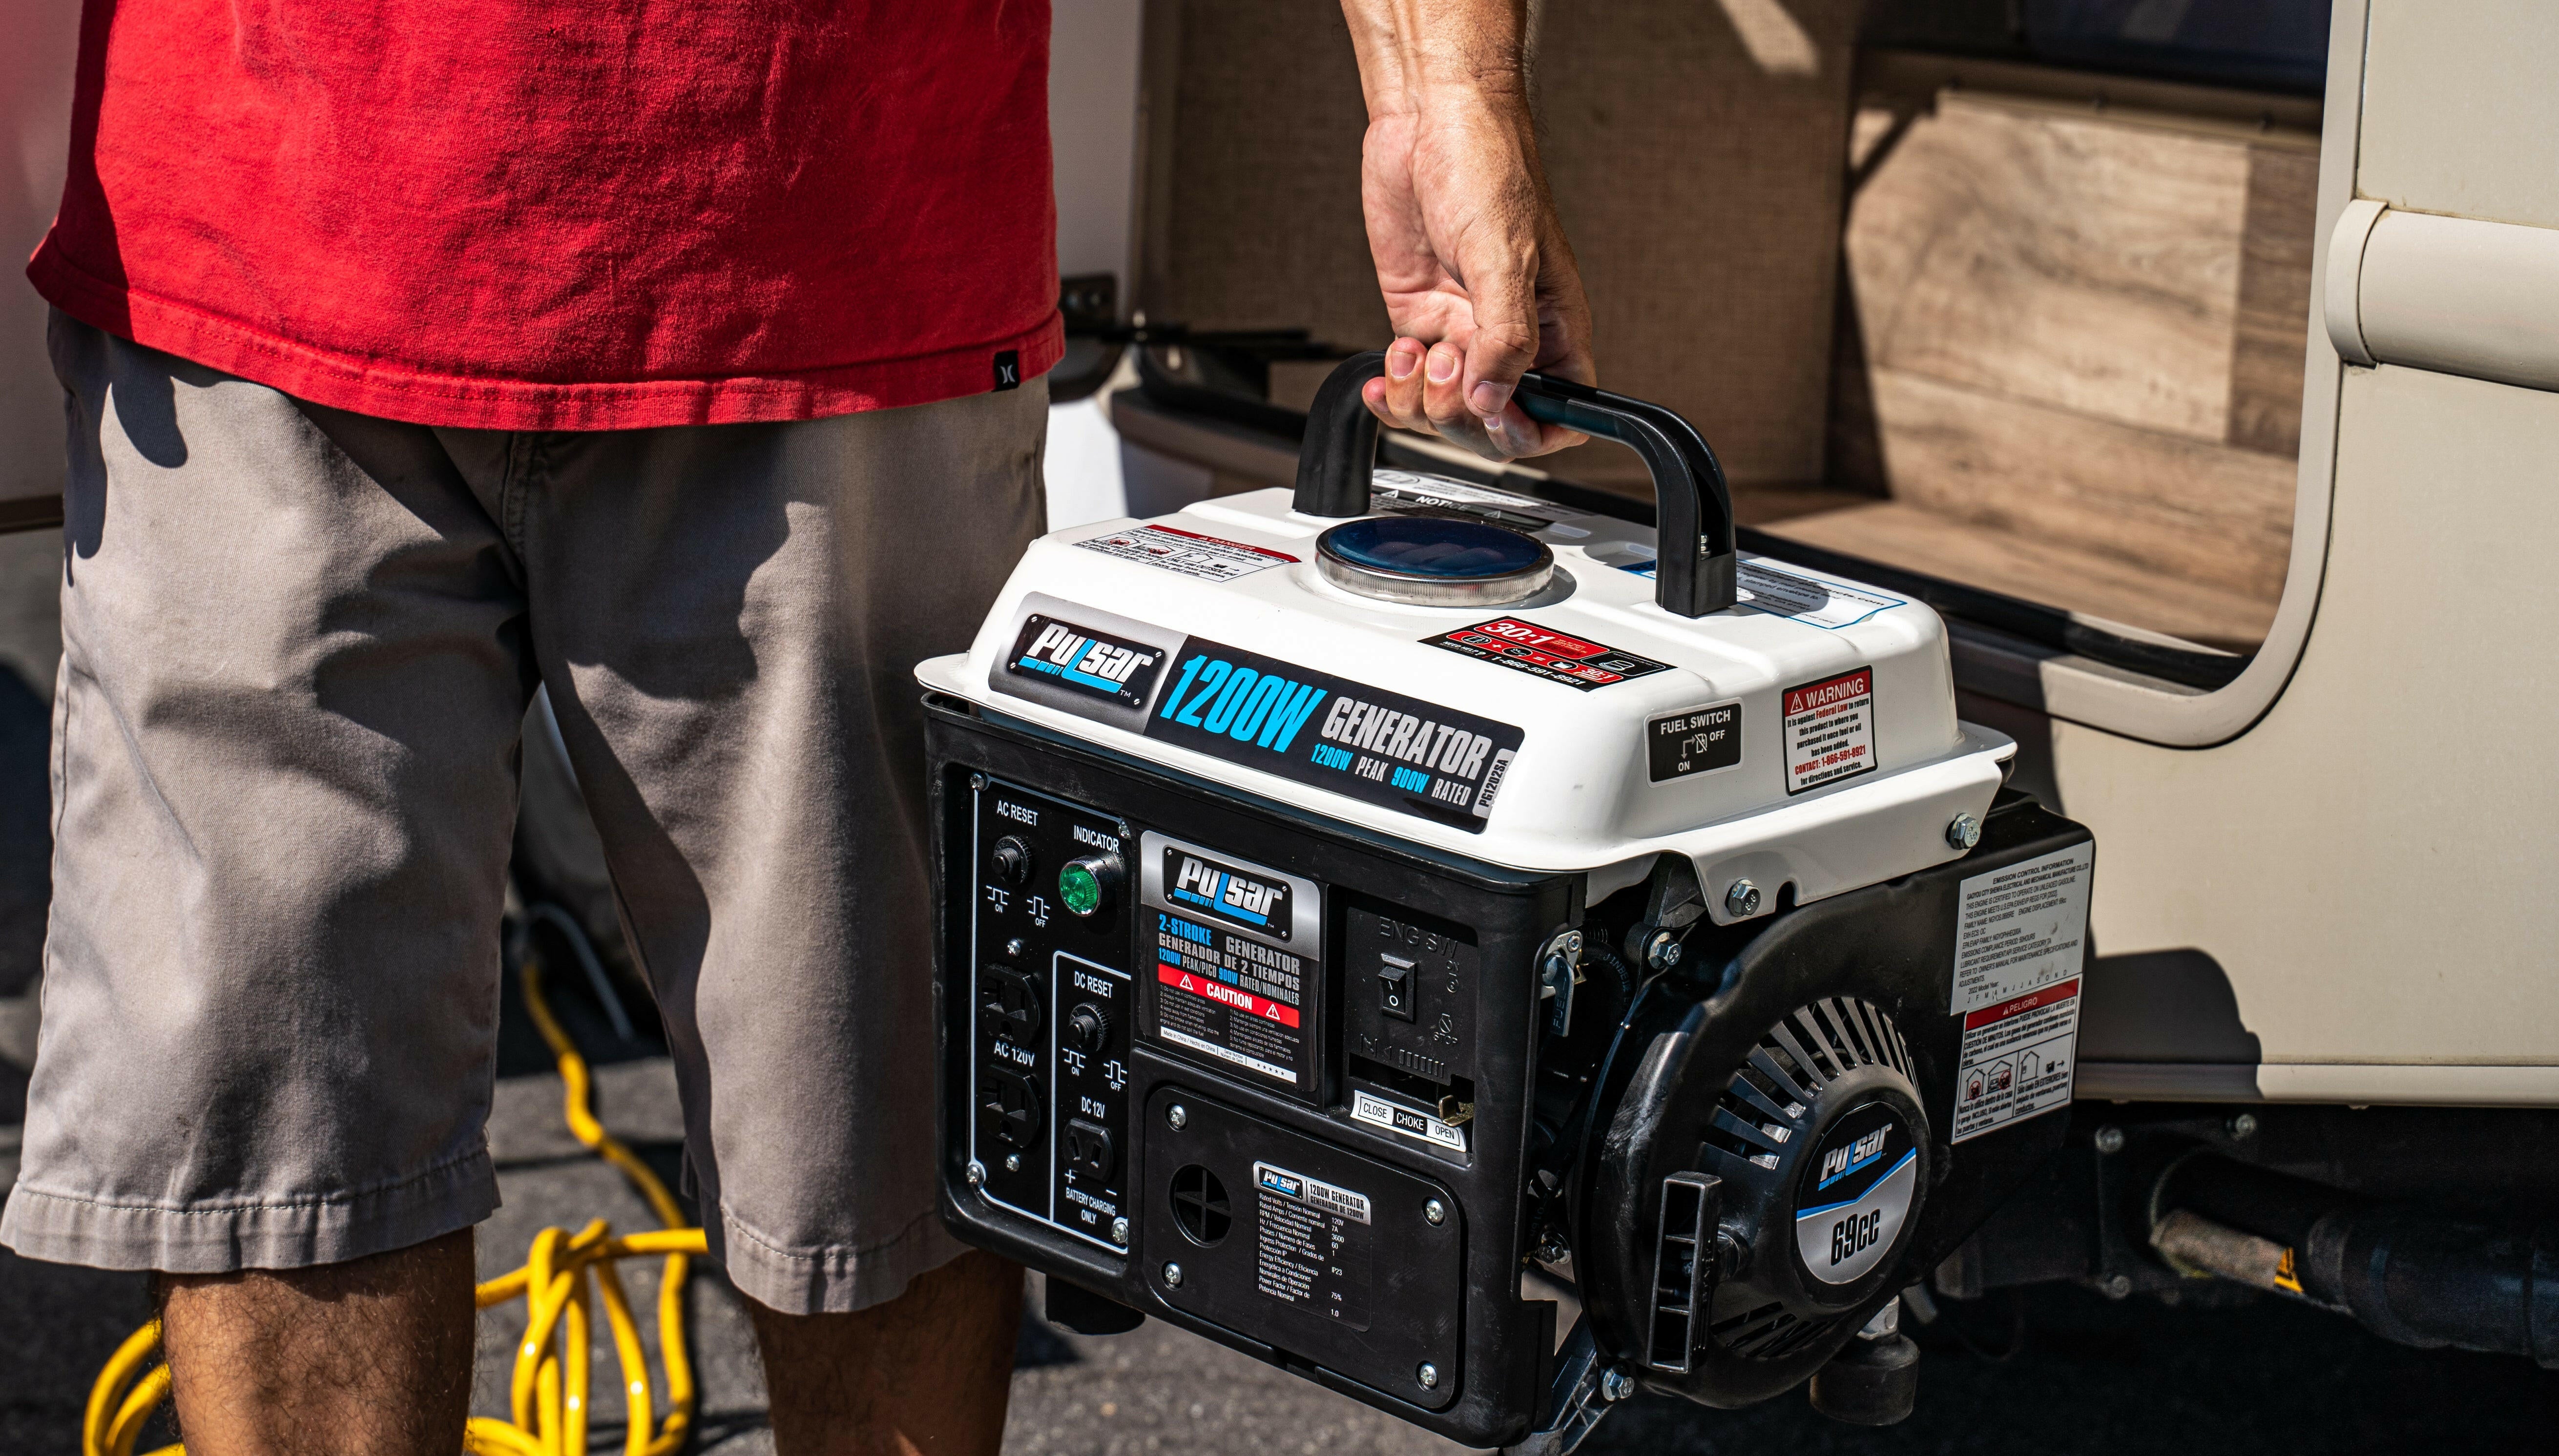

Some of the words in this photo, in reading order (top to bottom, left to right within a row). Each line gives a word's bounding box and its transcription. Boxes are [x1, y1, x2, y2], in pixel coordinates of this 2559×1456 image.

[1415, 496, 1472, 511] NOTICE
[1207, 538, 1256, 551] DANGER
[1484, 623, 1557, 645] 30:1
[1460, 645, 1486, 656] HELP?
[1492, 657, 1586, 685] 1-866-591-8921
[1582, 668, 1615, 679] 30:1
[1806, 678, 1864, 708] WARNING
[1160, 655, 1328, 752] 1200W
[1321, 696, 1492, 780] GENERATOR
[1661, 719, 1687, 735] FUEL
[1690, 709, 1730, 728] SWITCH
[1797, 713, 1815, 725] against
[1816, 705, 1836, 719] Federal
[1837, 703, 1848, 712] Law
[1854, 698, 1869, 707] return
[1709, 729, 1725, 741] OFF
[1799, 727, 1809, 736] this
[1809, 721, 1828, 734] product
[1834, 716, 1849, 726] where
[1849, 713, 1858, 722] you
[1796, 734, 1822, 749] purchased
[1827, 731, 1838, 740] once
[1839, 727, 1849, 736] fuel
[1811, 749, 1820, 757] has
[1820, 745, 1832, 754] been
[1833, 739, 1849, 750] added.
[1678, 761, 1690, 771] ON
[1795, 760, 1820, 774] CONTACT:
[1822, 745, 1865, 766] 1-866-591-8921
[1311, 743, 1351, 771] 1200W
[1355, 755, 1389, 782] PEAK
[1391, 767, 1430, 794] 900W
[1431, 778, 1470, 806] RATED
[1479, 758, 1509, 808] PG1202SA
[1808, 770, 1832, 783] directions
[1833, 766, 1842, 775] and
[1843, 762, 1862, 772] service.
[997, 800, 1009, 816] AC
[1011, 805, 1038, 826] RESET
[1074, 825, 1120, 853] INDICATOR
[1993, 873, 2017, 885] EMISSION
[2017, 867, 2040, 878] CONTROL
[2041, 858, 2074, 873] INFORMATION
[995, 904, 1003, 913] ON
[1035, 918, 1046, 928] OFF
[1159, 915, 1211, 945] 2-STROKE
[1226, 936, 1299, 974] GENERATOR
[1379, 916, 1419, 946] ENG
[1426, 933, 1458, 958] SW
[1159, 933, 1219, 963] GENERADOR
[1225, 954, 1236, 970] DE
[1241, 960, 1248, 973] 2
[1252, 964, 1299, 990] TIEMPOS
[1075, 971, 1086, 988] DC
[1087, 974, 1113, 998] RESET
[1159, 948, 1181, 966] 1200W
[1183, 956, 1216, 977] PEAK/PICO
[1219, 968, 1237, 984] 900W
[1240, 975, 1298, 1003] RATED/NOMINALES
[1207, 983, 1252, 1010] CAUTION
[2009, 996, 2038, 1013] PELIGRO
[1434, 1032, 1458, 1046] STOP
[994, 1040, 1010, 1059] AC
[1011, 1045, 1035, 1067] 120V
[1071, 1067, 1080, 1076] ON
[1111, 1081, 1121, 1092] OFF
[1082, 1096, 1092, 1114] DC
[1093, 1101, 1105, 1119] 12V
[1364, 1104, 1387, 1119] CLOSE
[1396, 1113, 1424, 1131] CHOKE
[1435, 1125, 1455, 1140] OPEN
[1066, 1187, 1088, 1208] BATTERY
[1089, 1196, 1116, 1216] CHARGING
[1310, 1183, 1329, 1199] 1200W
[1331, 1190, 1364, 1209] GENERATOR
[1310, 1195, 1338, 1211] GENERADOR
[1339, 1205, 1346, 1214] DE
[1346, 1207, 1364, 1219] 1200W
[1082, 1209, 1097, 1225] ONLY
[1332, 1217, 1343, 1226] 120V
[1332, 1233, 1344, 1243] 3600
[1331, 1267, 1342, 1275] IP23
[1332, 1291, 1341, 1301] 75%
